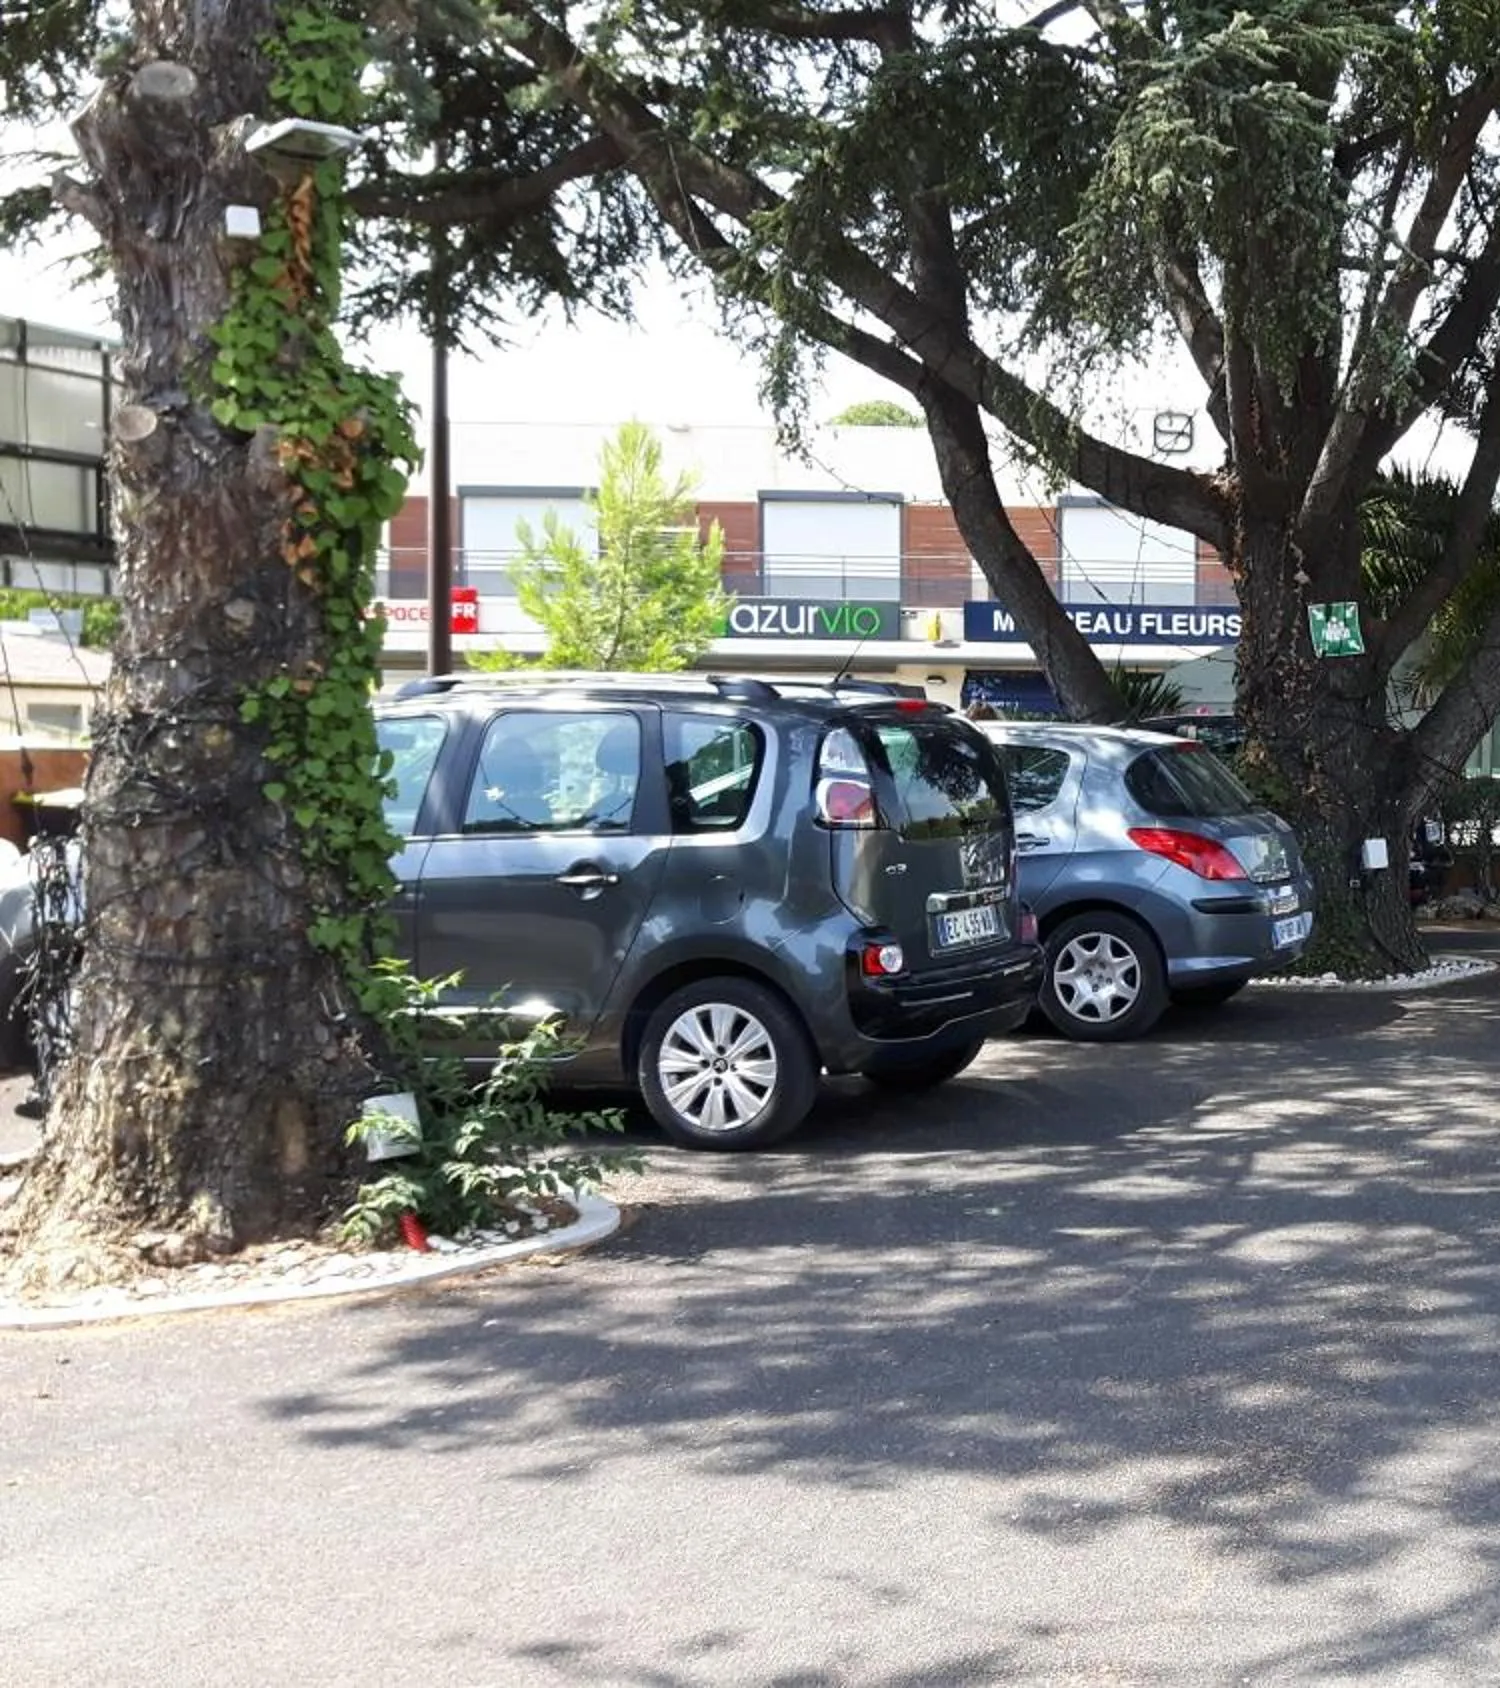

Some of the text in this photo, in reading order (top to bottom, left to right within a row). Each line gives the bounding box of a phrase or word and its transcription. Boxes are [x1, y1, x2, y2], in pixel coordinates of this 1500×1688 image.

[729, 602, 881, 634] azurvio
[992, 609, 1242, 637] MEAU FLEURS
